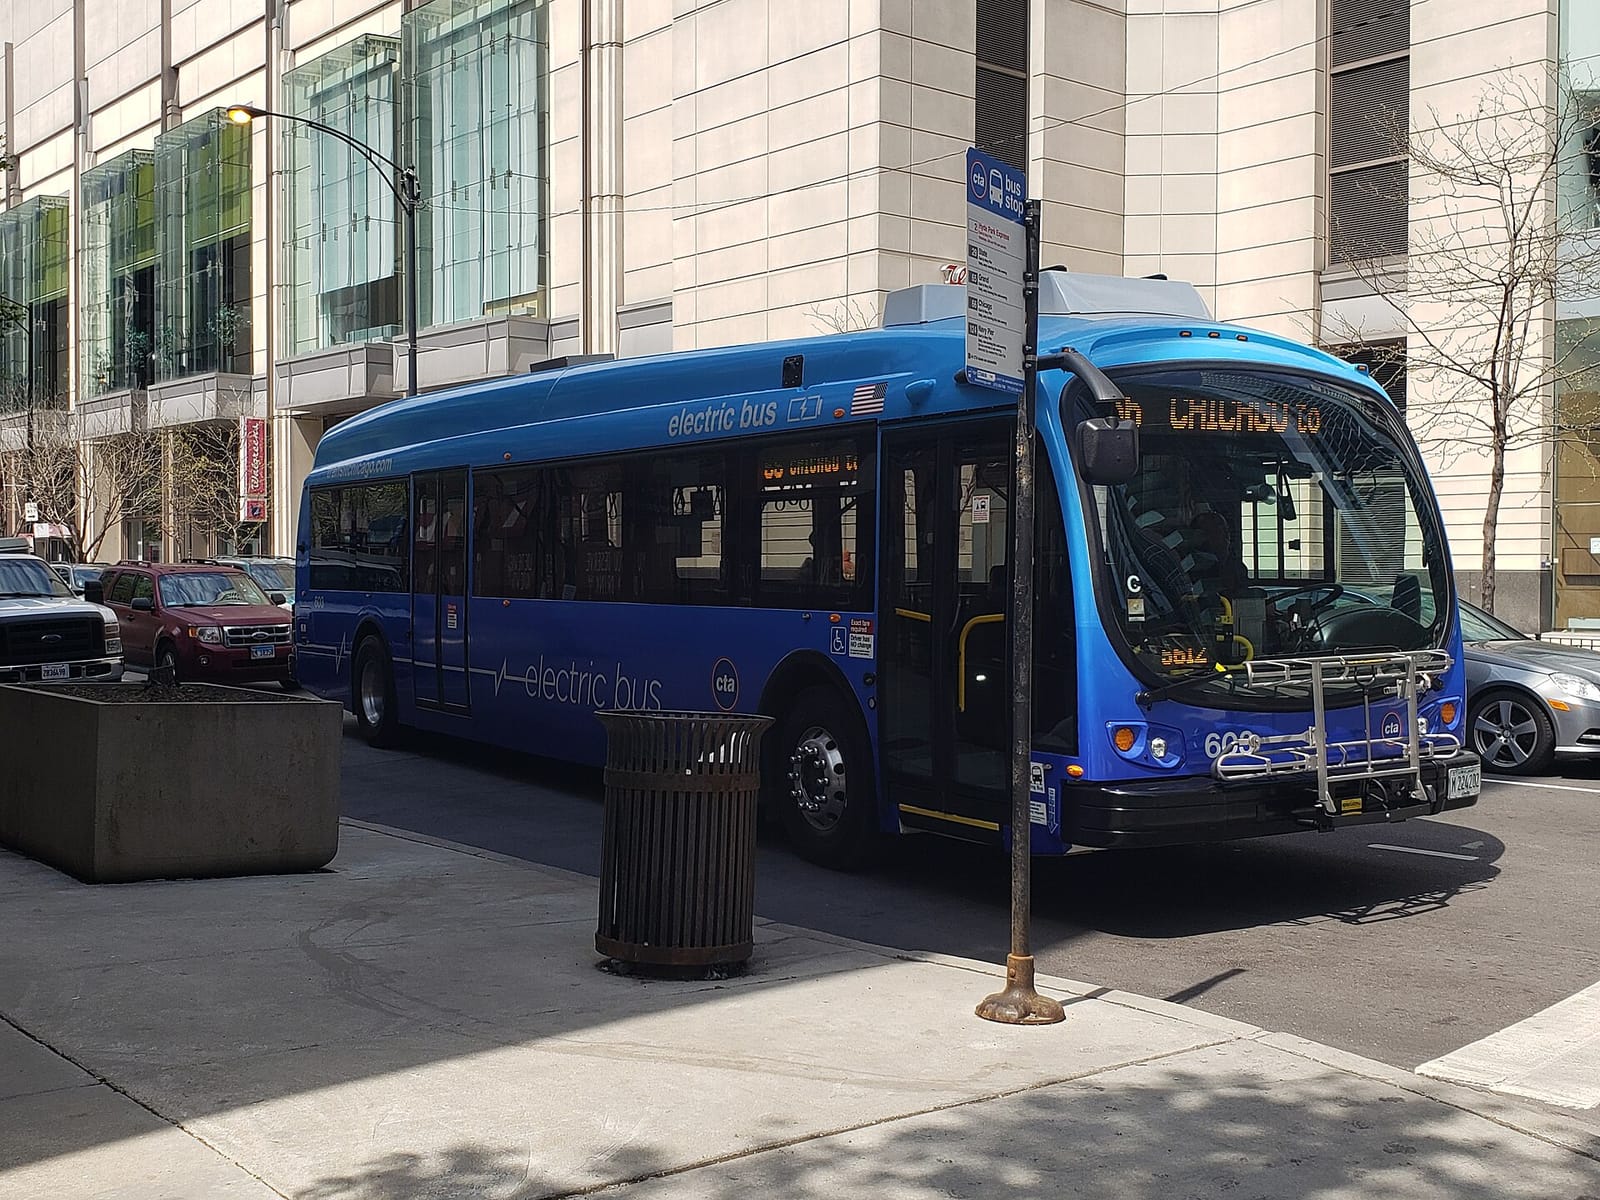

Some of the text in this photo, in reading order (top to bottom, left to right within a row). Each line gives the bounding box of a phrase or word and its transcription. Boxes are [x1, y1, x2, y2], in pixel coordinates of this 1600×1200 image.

[972, 171, 985, 188] cta
[1005, 174, 1021, 196] bus
[1005, 196, 1024, 217] stop
[668, 399, 777, 437] electric bus
[1127, 575, 1141, 593] C
[525, 654, 662, 711] electric bus
[716, 674, 735, 693] cta
[1384, 722, 1399, 735] cta
